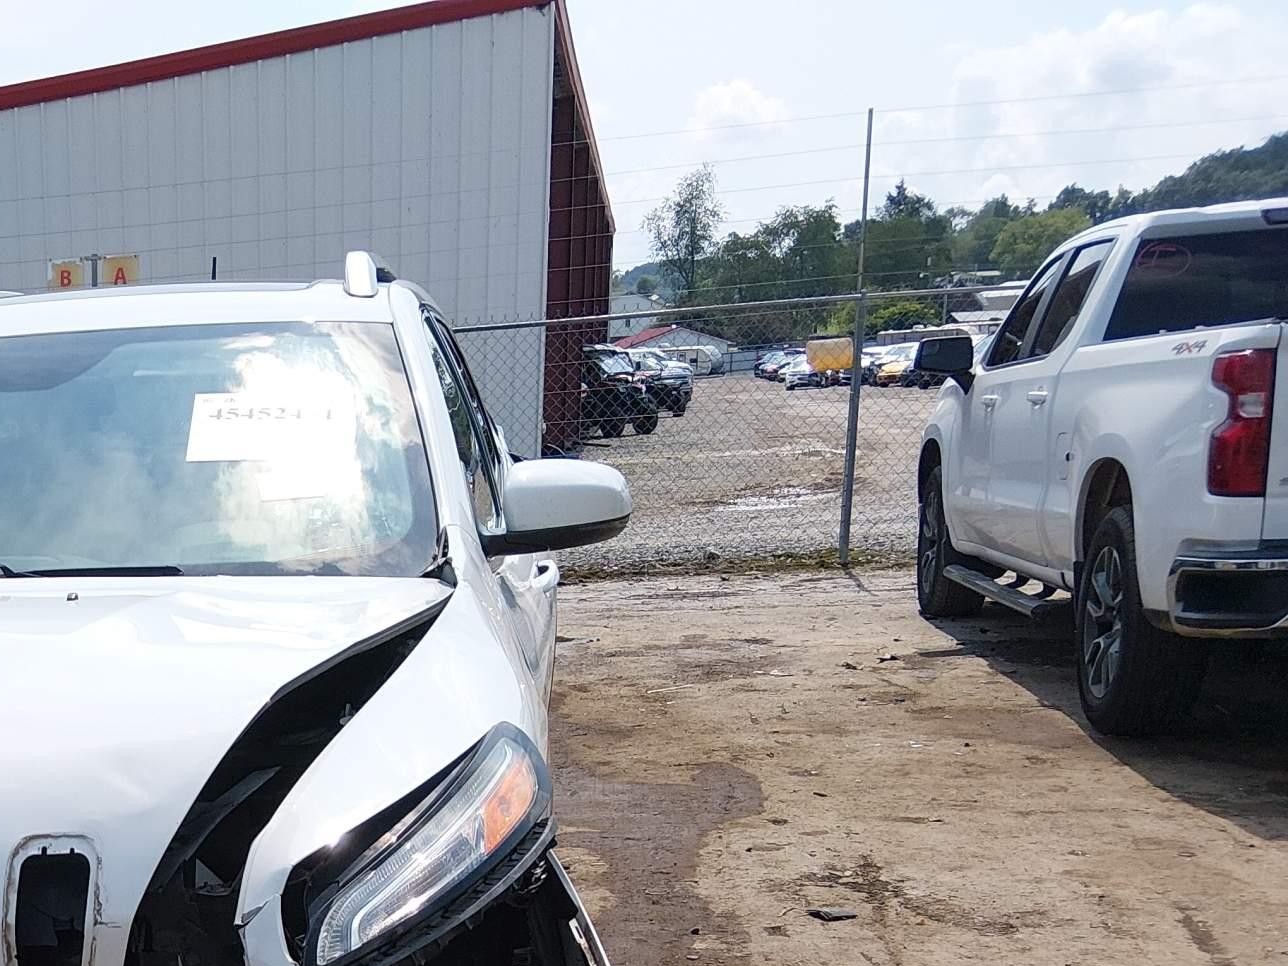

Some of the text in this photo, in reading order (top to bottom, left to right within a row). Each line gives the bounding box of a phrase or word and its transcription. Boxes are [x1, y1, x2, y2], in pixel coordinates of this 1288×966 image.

[60, 270, 72, 287] B
[114, 267, 127, 285] A
[208, 407, 332, 420] 4545241
